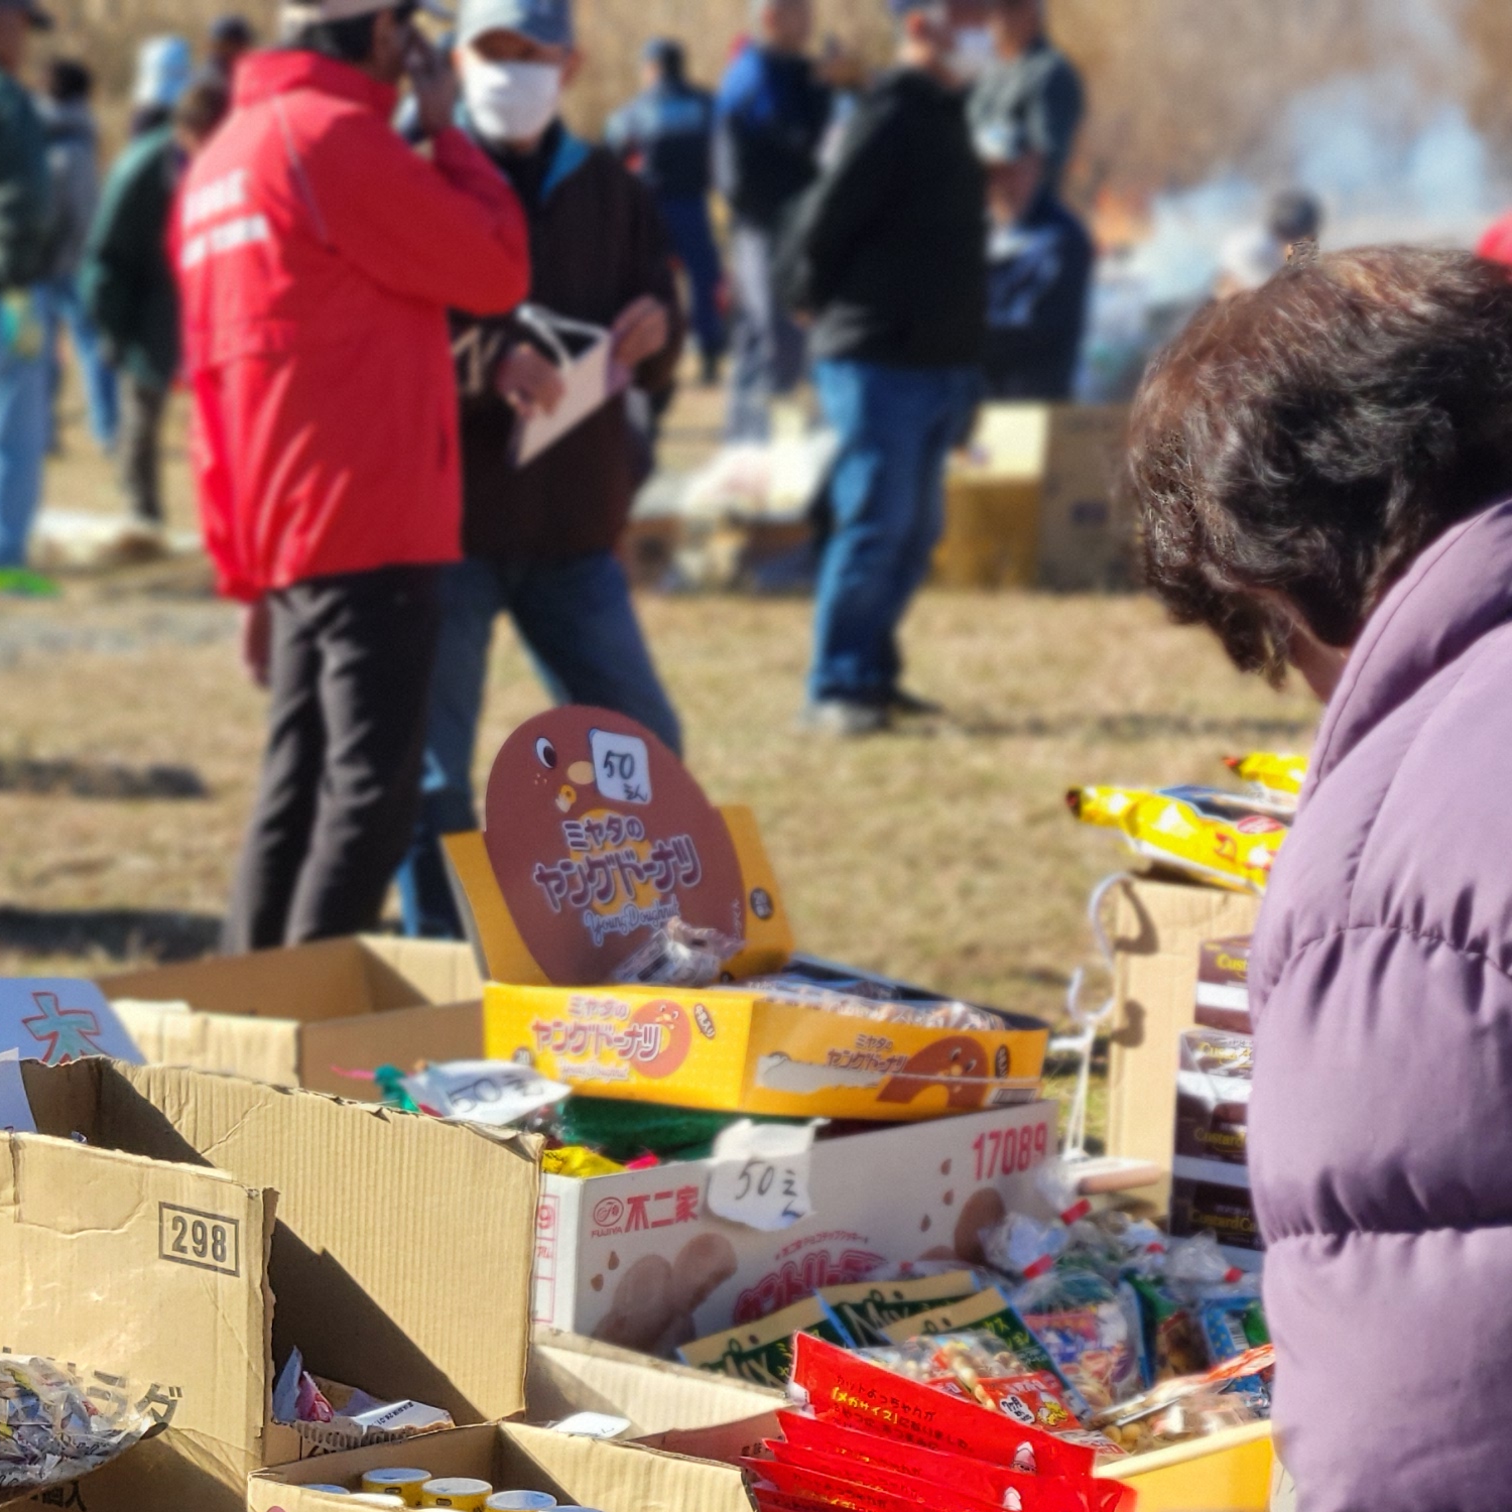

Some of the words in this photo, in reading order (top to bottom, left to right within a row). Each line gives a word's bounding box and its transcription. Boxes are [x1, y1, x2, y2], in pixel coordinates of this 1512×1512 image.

[603, 750, 635, 780] 50
[563, 814, 646, 850] ミヤタの
[534, 834, 702, 912] ヤングドーナツ
[568, 994, 630, 1021] ミヤタの
[531, 1020, 662, 1063] ヤングドーナツ
[972, 1122, 1048, 1183] 17089
[624, 1184, 700, 1234] 不二家
[170, 1215, 228, 1264] 298
[591, 1226, 623, 1239] FUJIYA
